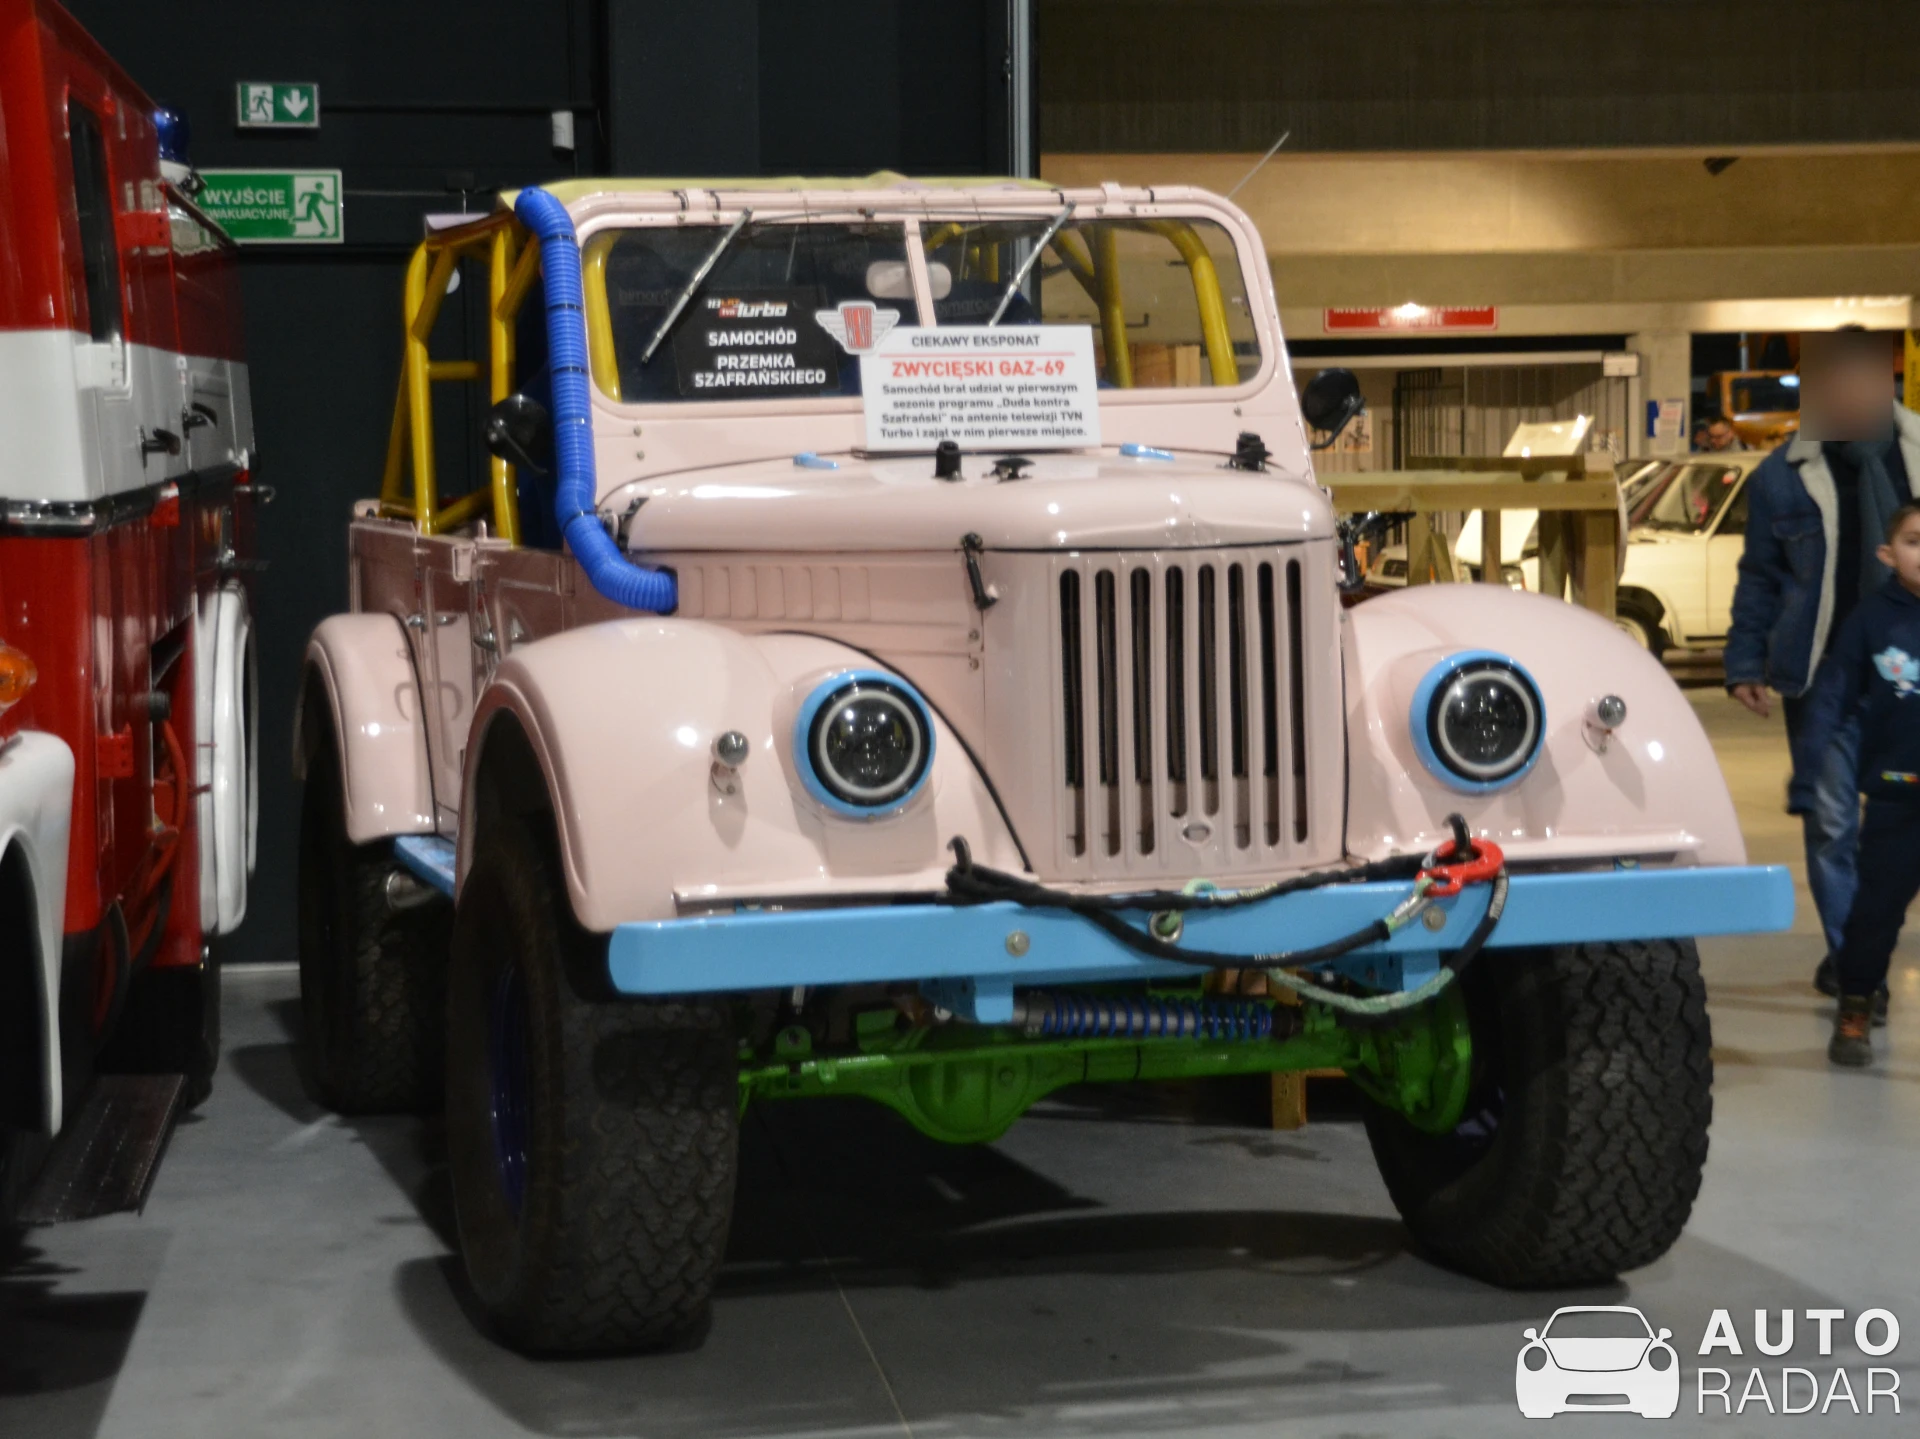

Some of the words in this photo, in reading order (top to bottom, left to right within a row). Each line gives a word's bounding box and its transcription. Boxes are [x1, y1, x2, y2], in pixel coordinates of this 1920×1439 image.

[204, 187, 286, 205] WYJŚCIE
[708, 327, 797, 347] SAMOCHÓD
[911, 335, 969, 348] CIEKAWY
[973, 335, 1041, 347] EKSPONAT
[717, 353, 796, 371] PRZEMKA
[891, 360, 994, 380] ZWYCIĘSKI
[999, 360, 1066, 377] GAZ-69
[694, 368, 827, 388] SZAFRAŃSKIEGO
[882, 384, 941, 395] Samochód
[1005, 385, 1015, 393] w
[1017, 382, 1079, 395] pierwszym
[893, 398, 936, 409] sezonie
[938, 399, 994, 411] programu
[1033, 398, 1071, 407] kontra
[950, 414, 964, 423] na
[967, 412, 1009, 423] antenie
[1011, 410, 1058, 423] telewizji
[1060, 411, 1083, 421] TVN
[880, 428, 914, 438] Turbo
[951, 429, 961, 437] w
[964, 427, 985, 438] nim
[988, 426, 1038, 439] pierwsze
[1041, 426, 1088, 438] miejsce.
